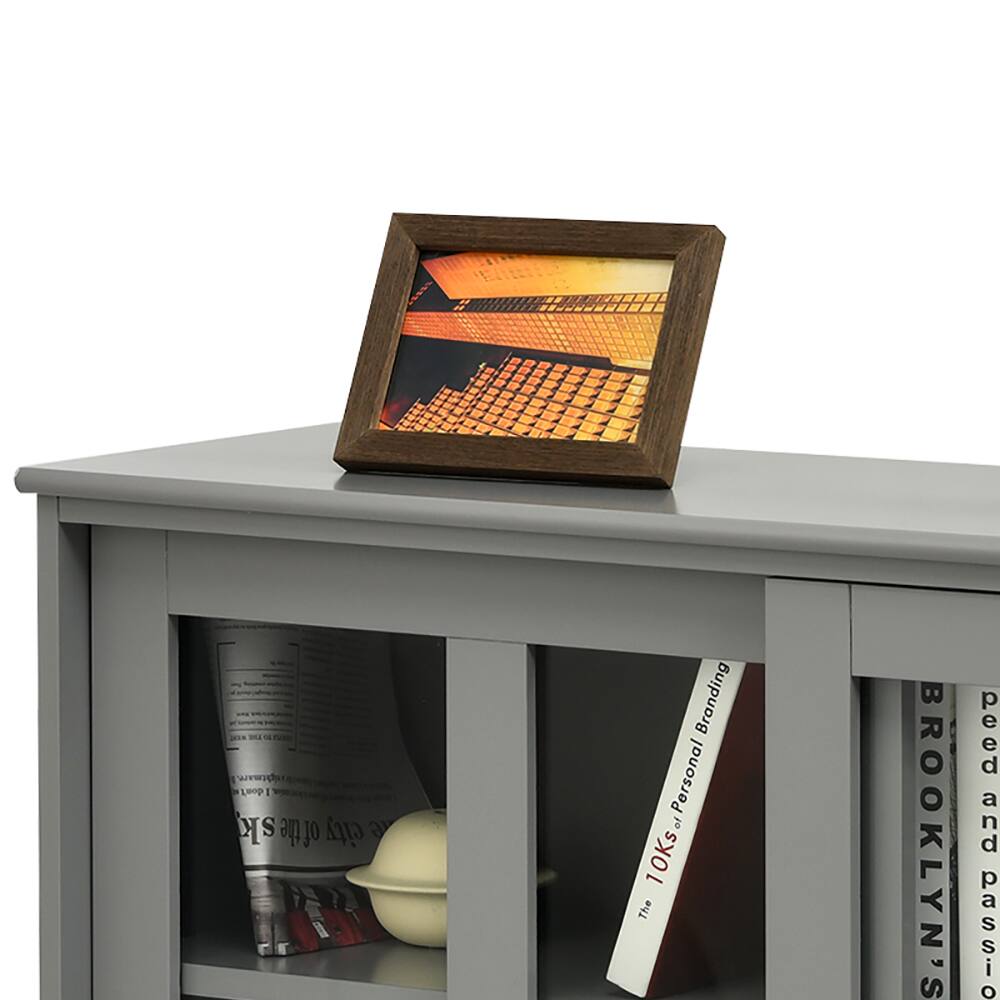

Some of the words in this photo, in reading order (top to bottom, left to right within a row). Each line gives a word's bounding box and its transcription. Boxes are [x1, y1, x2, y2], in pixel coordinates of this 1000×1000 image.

[695, 661, 730, 735] Branding
[981, 690, 999, 775] peed
[671, 737, 704, 813] Personal
[280, 817, 300, 847] the
[303, 820, 320, 848] of
[326, 815, 364, 848] city
[674, 816, 682, 830] of
[981, 792, 998, 853] and
[645, 830, 678, 885] 10Ks
[638, 899, 652, 920] The
